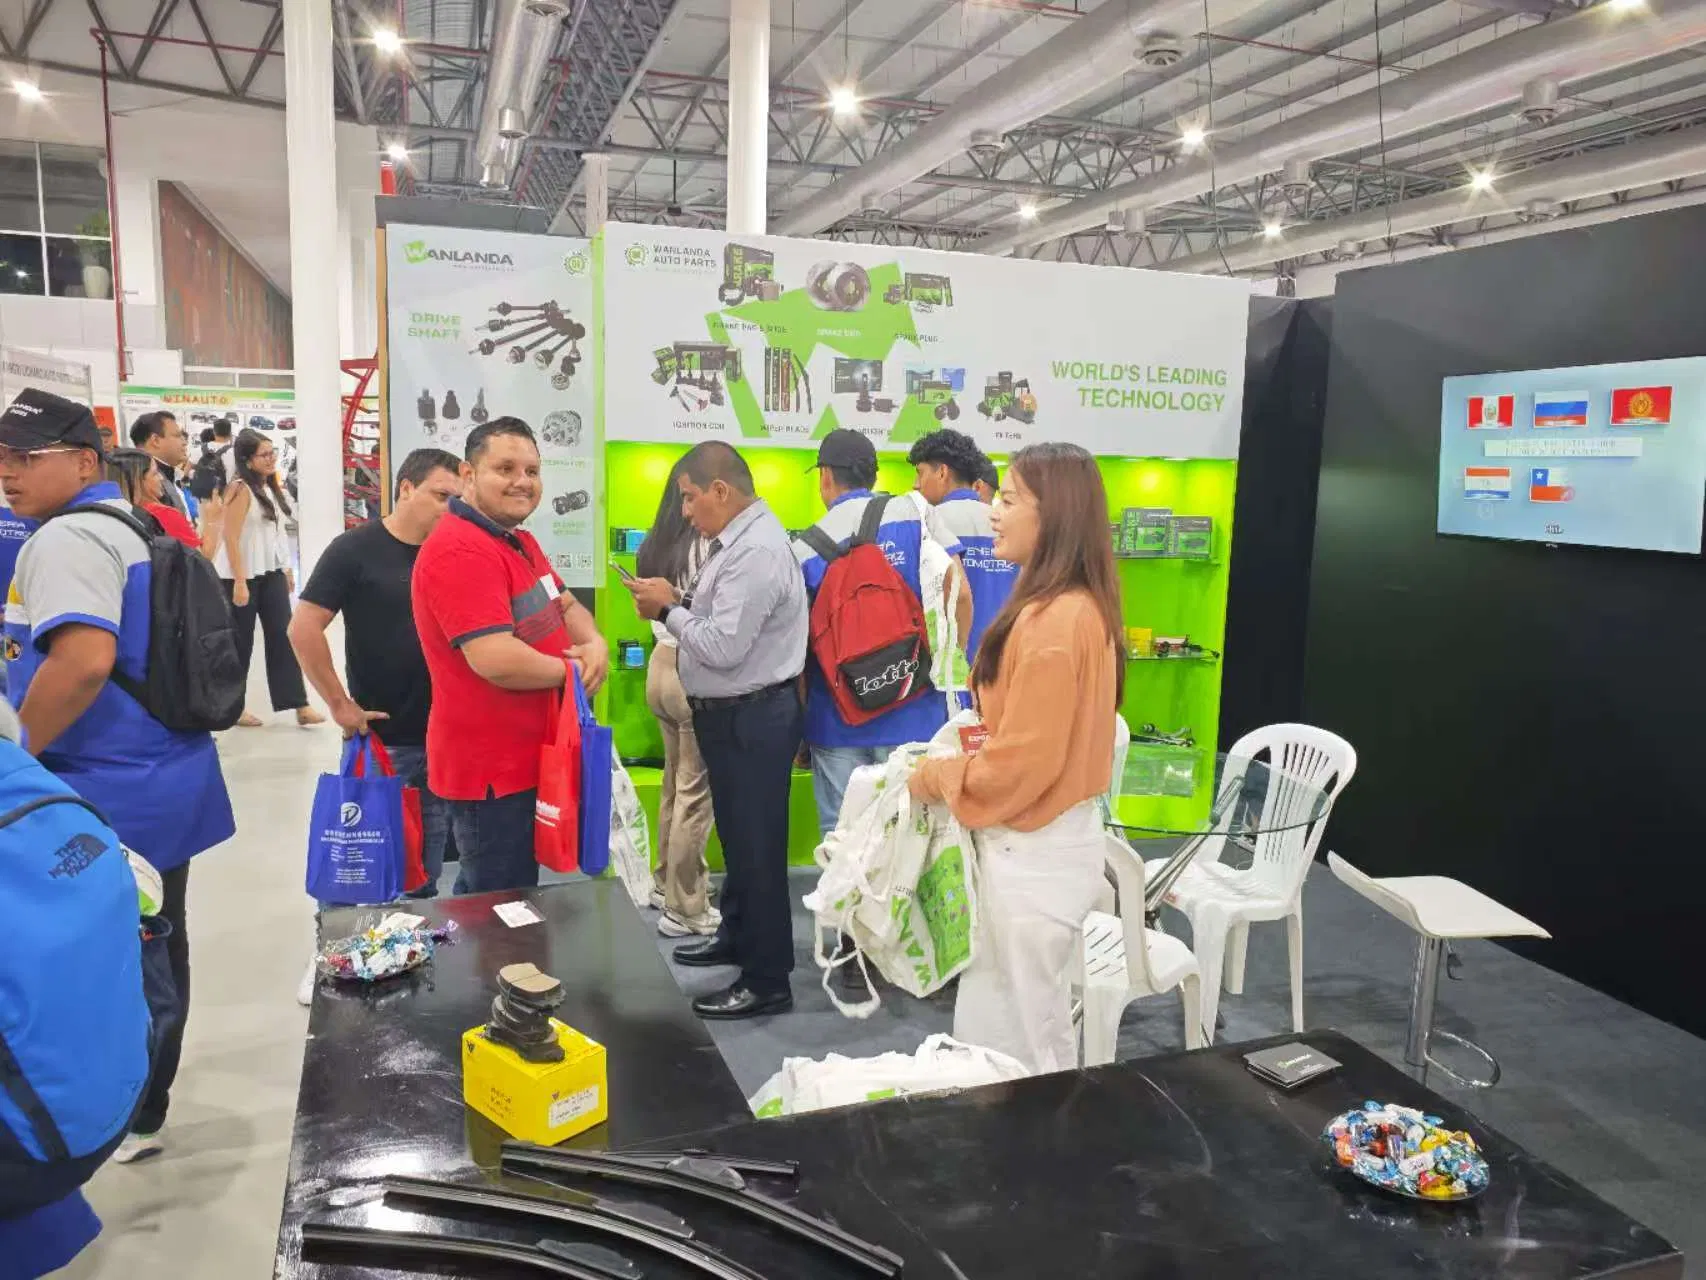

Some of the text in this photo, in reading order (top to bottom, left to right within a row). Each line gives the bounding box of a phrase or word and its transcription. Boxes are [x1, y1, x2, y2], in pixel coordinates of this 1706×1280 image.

[403, 239, 514, 266] WANLANDA
[653, 244, 711, 257] WANLANDA
[654, 255, 717, 269] AUTO PARTS
[411, 312, 461, 326] DRIVE
[407, 327, 462, 342] SHAFT
[1051, 360, 1227, 386] WORLD'S LEADING
[1077, 387, 1226, 412] TECHNOLOGY
